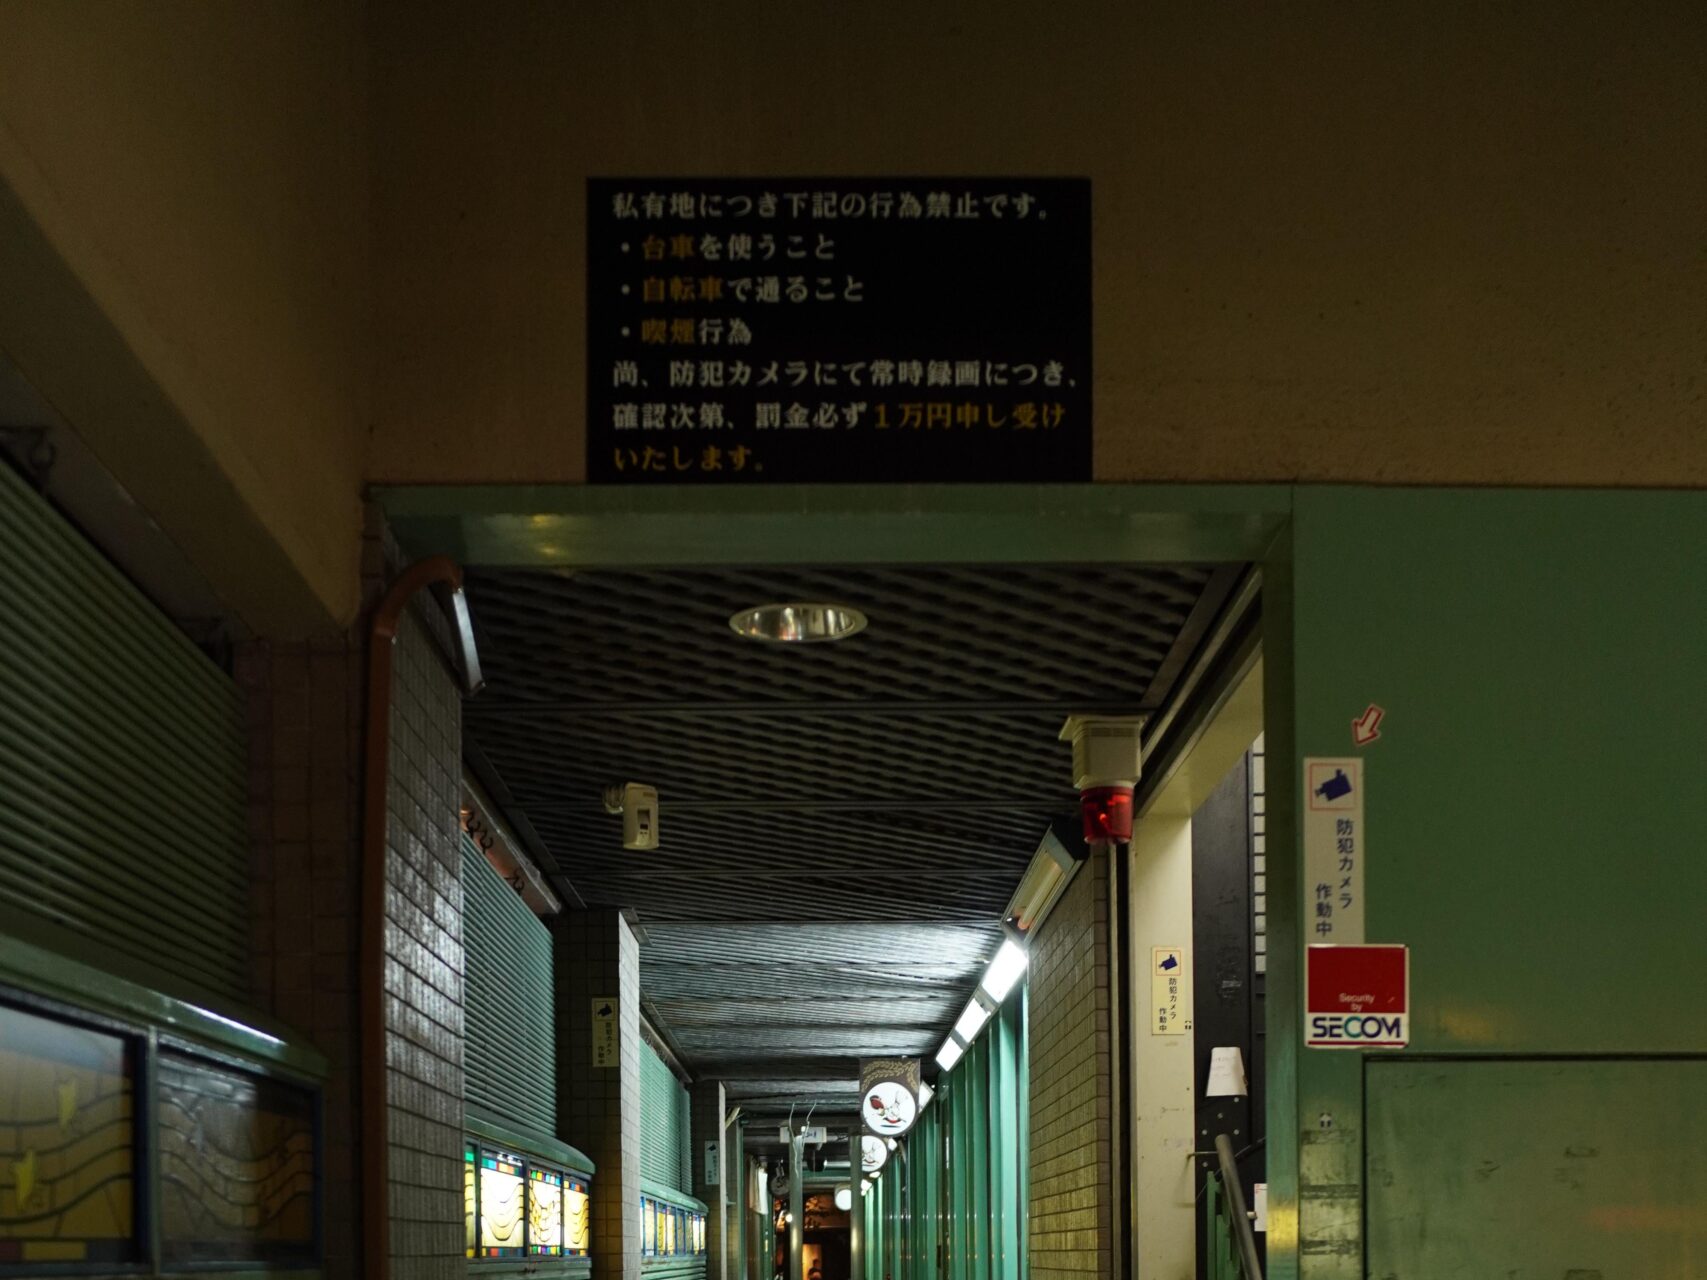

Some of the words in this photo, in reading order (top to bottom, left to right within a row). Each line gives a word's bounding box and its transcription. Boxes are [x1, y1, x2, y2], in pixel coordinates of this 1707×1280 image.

[612, 191, 1048, 220] 私有地につき下記の行為禁止です。
[613, 445, 765, 473] いたします。
[1337, 818, 1354, 909] 防犯カメラ
[1316, 883, 1332, 937] 作動中
[1168, 977, 1177, 1020] 防犯カメラ
[1338, 992, 1376, 1005] Security
[1158, 1007, 1167, 1032] 作動中
[1312, 1016, 1401, 1039] SECOM
